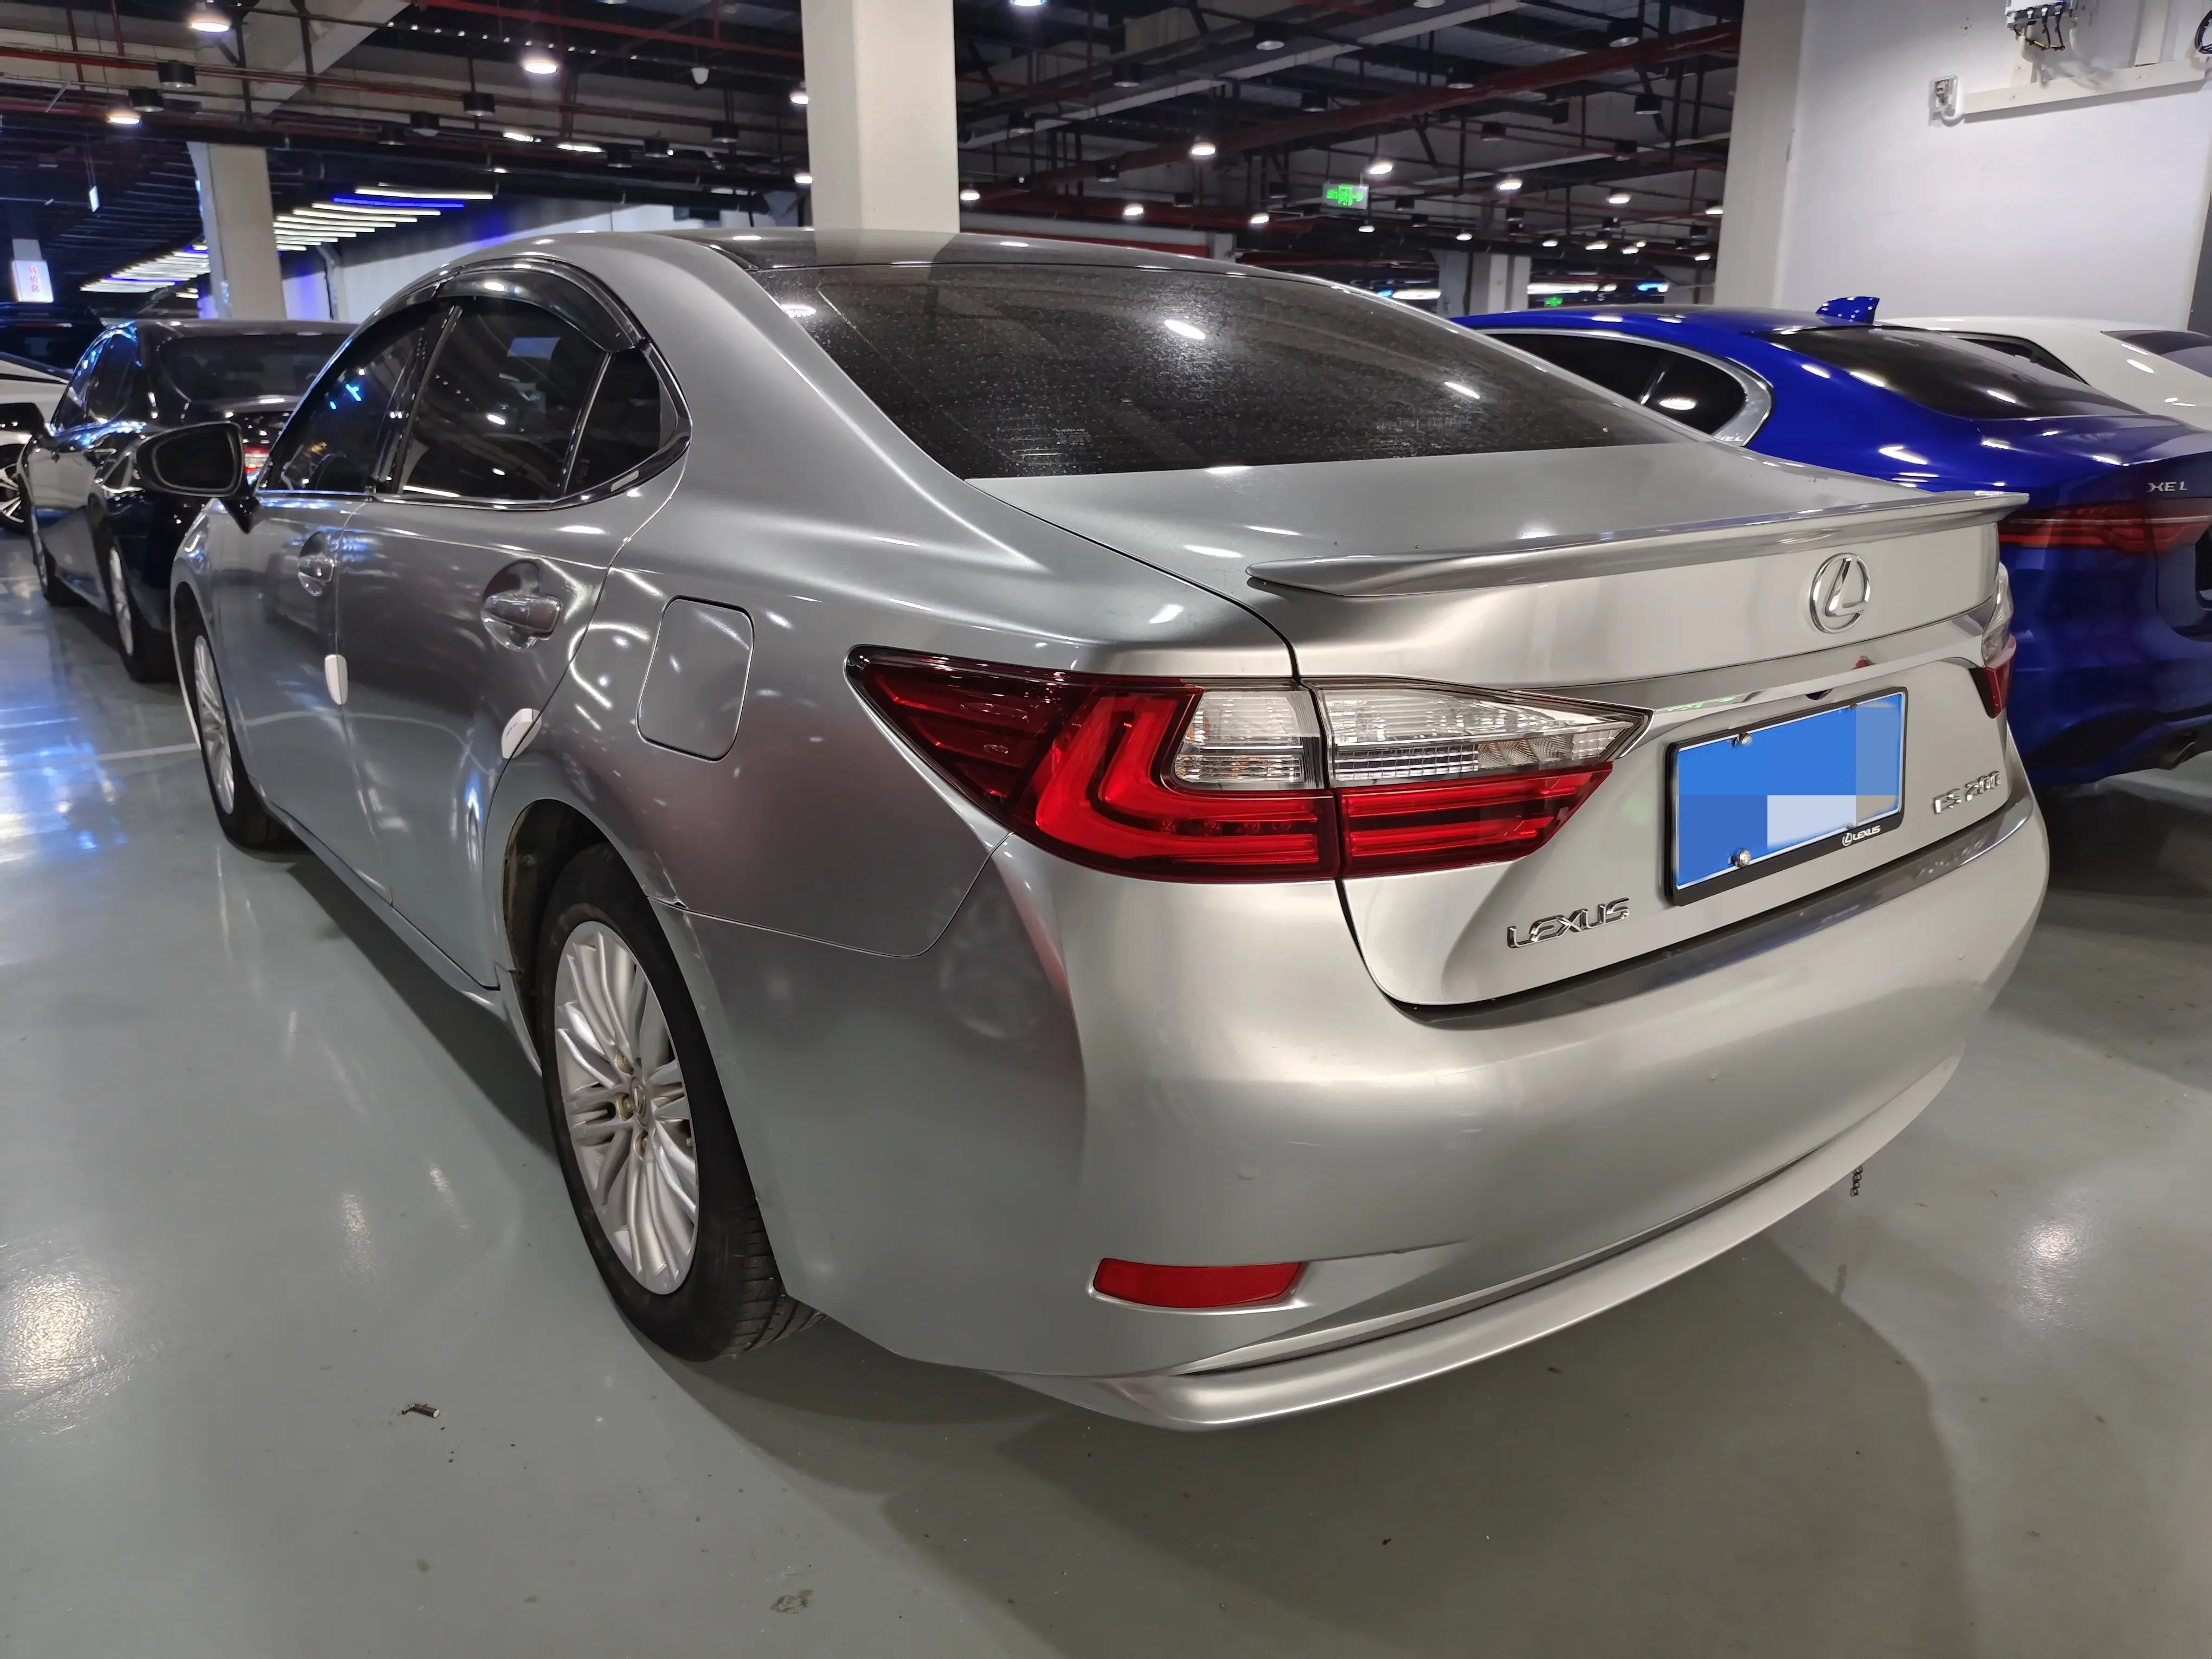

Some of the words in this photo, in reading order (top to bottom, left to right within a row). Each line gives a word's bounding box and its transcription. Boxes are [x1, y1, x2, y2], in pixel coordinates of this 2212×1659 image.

[1933, 788, 1962, 814] ES
[1965, 770, 2001, 801] 200
[1853, 825, 1881, 840] LEXUS
[1507, 897, 1630, 949] LEXUS
